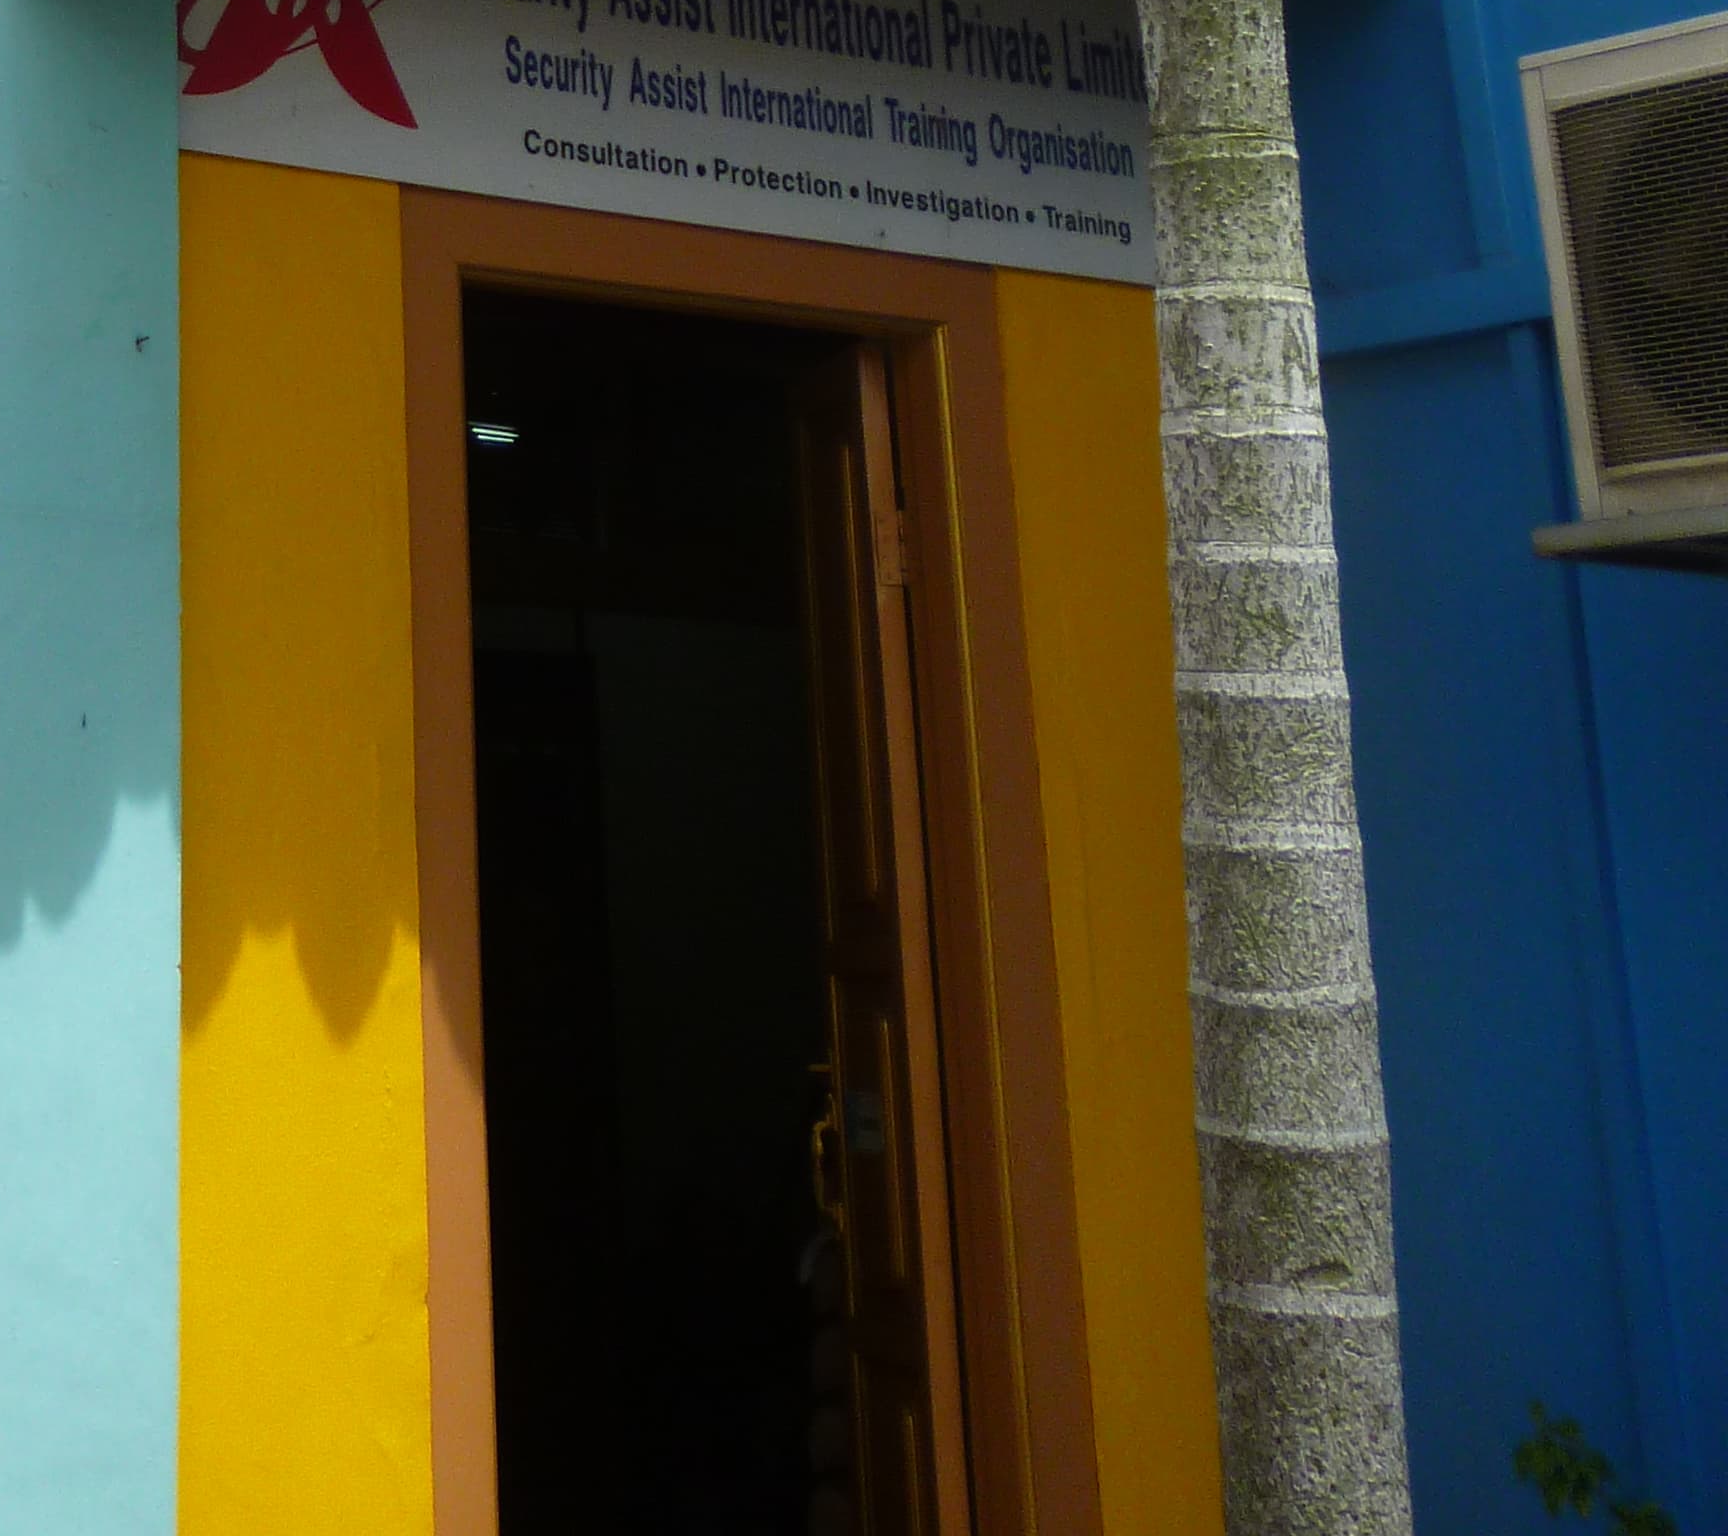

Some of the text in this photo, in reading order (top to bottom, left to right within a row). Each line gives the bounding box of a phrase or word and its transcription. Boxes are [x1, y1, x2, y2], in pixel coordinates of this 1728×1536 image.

[941, 0, 1053, 89] Private
[505, 35, 1135, 178] Security Assist International Training Organisation
[524, 129, 1132, 245] Consultation Protection Investigation Training
